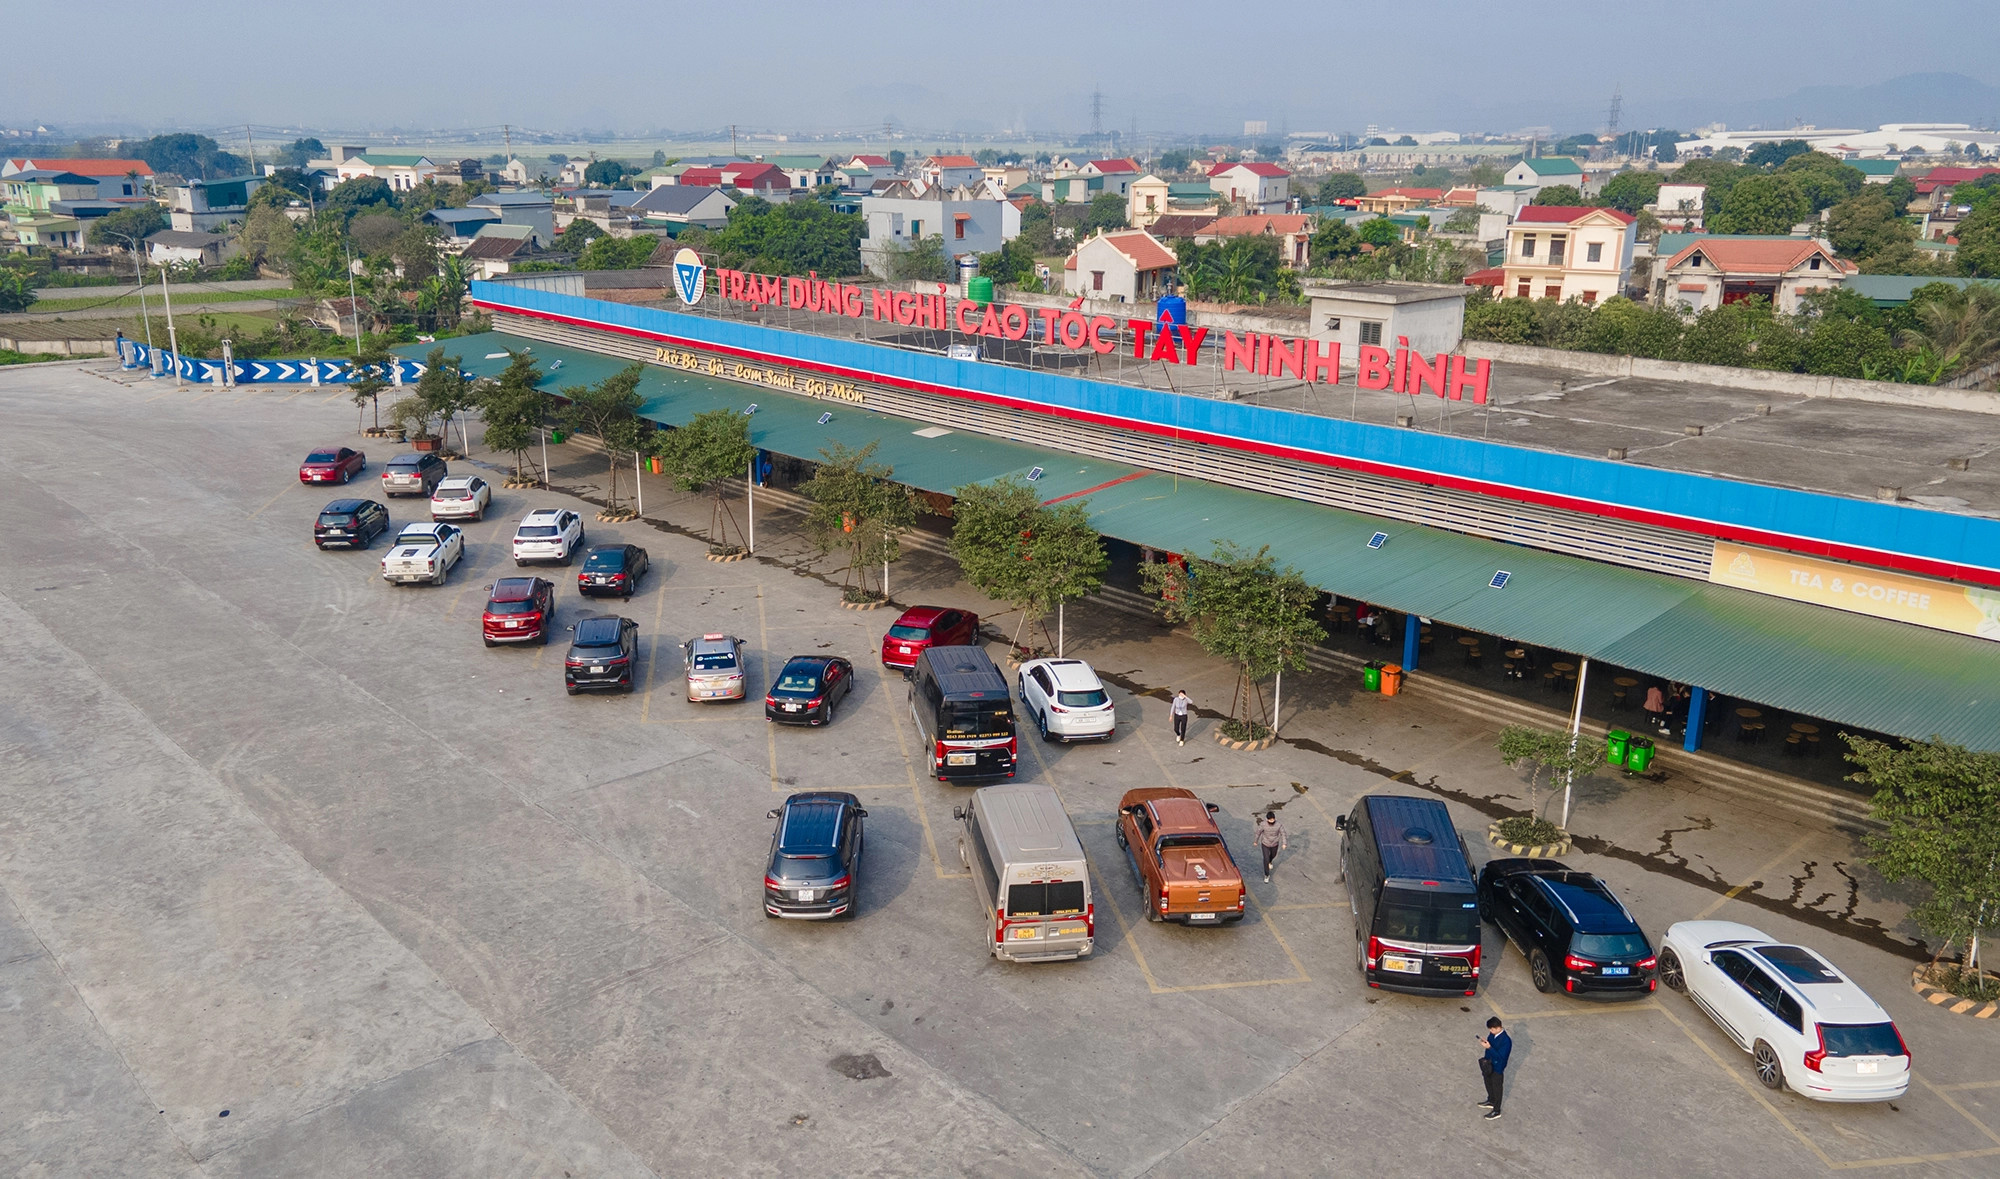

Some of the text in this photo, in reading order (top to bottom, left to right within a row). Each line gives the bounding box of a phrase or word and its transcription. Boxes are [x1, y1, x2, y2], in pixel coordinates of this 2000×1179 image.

[715, 268, 782, 312] TRẠM
[872, 282, 947, 330] NGHỈ
[955, 299, 1029, 341] CAO
[1128, 309, 1210, 366] TÂY
[1224, 330, 1341, 385] NINH
[1358, 335, 1491, 404] BÌNH
[656, 347, 864, 403] Phở Bò Gà Cơm Suất Gọi Món
[1790, 569, 1931, 610] TEA & COFFEE
